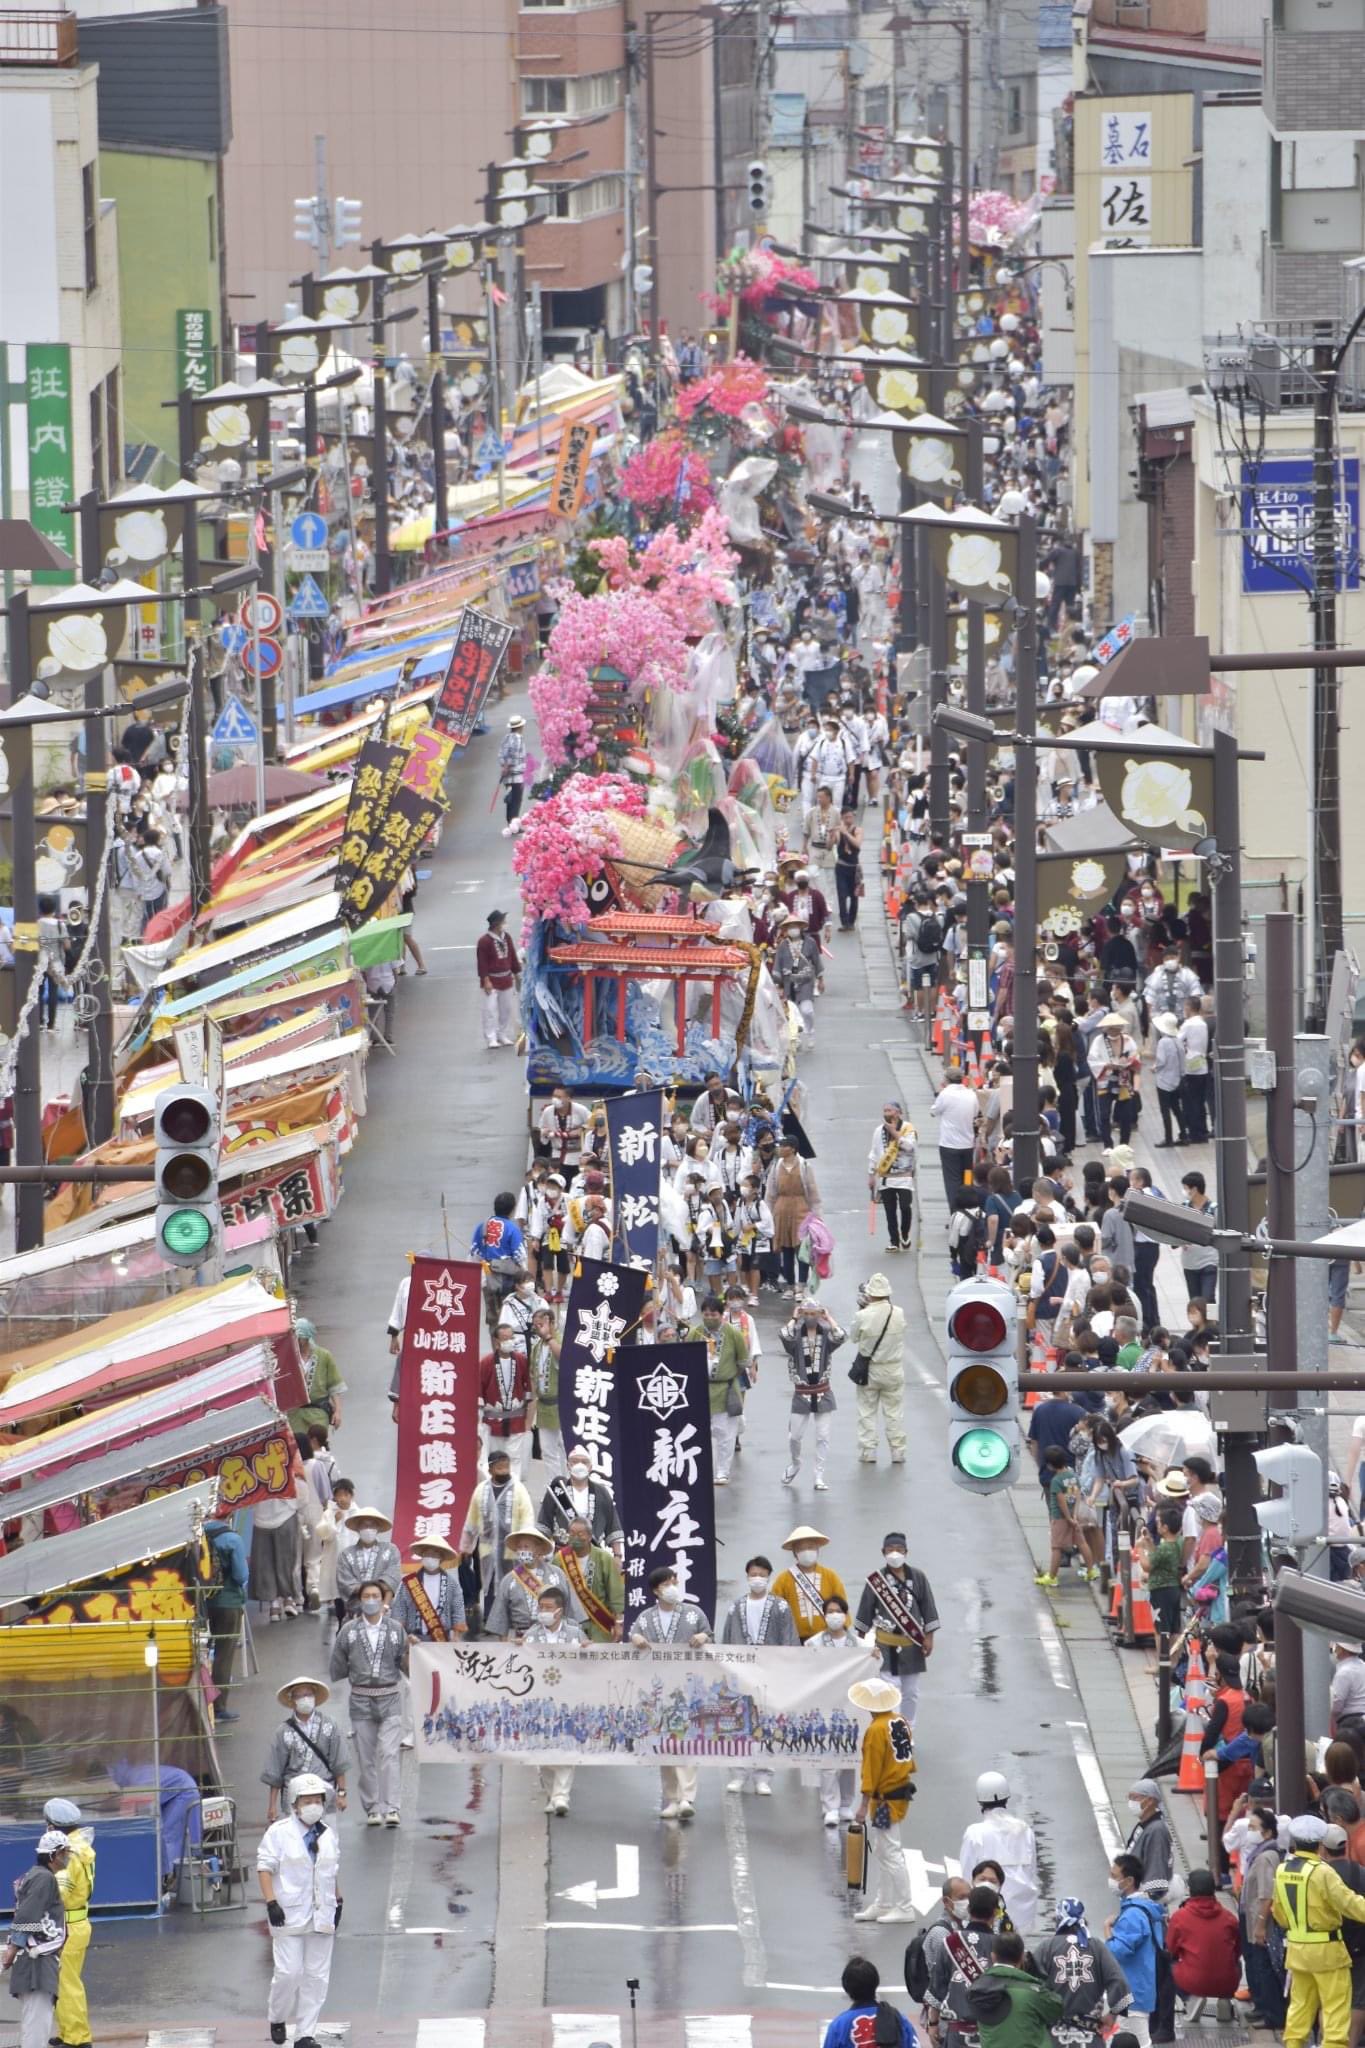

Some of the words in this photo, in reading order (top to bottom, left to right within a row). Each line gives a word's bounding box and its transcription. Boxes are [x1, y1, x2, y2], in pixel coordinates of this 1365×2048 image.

[1103, 116, 1150, 164] 墓石
[184, 312, 207, 399] 花の店こんた
[1252, 558, 1300, 569] Jeelry
[414, 1327, 467, 1353] 山形県
[627, 1529, 647, 1608] 山形県
